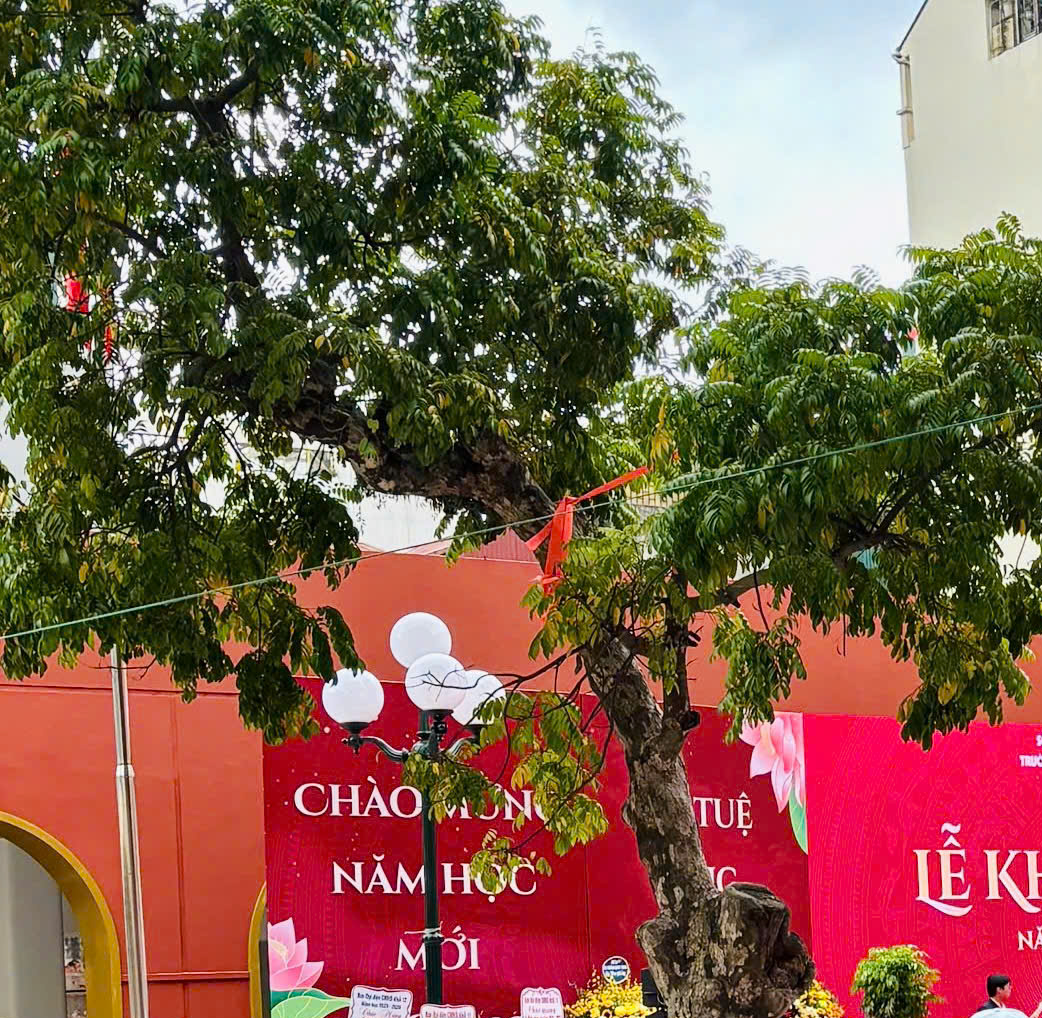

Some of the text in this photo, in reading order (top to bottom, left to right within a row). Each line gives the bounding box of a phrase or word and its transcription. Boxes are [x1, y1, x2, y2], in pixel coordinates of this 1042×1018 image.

[294, 776, 423, 818] CHÀO
[692, 790, 754, 837] TUỆ
[331, 854, 425, 894] NĂM
[914, 822, 972, 917] LỄ
